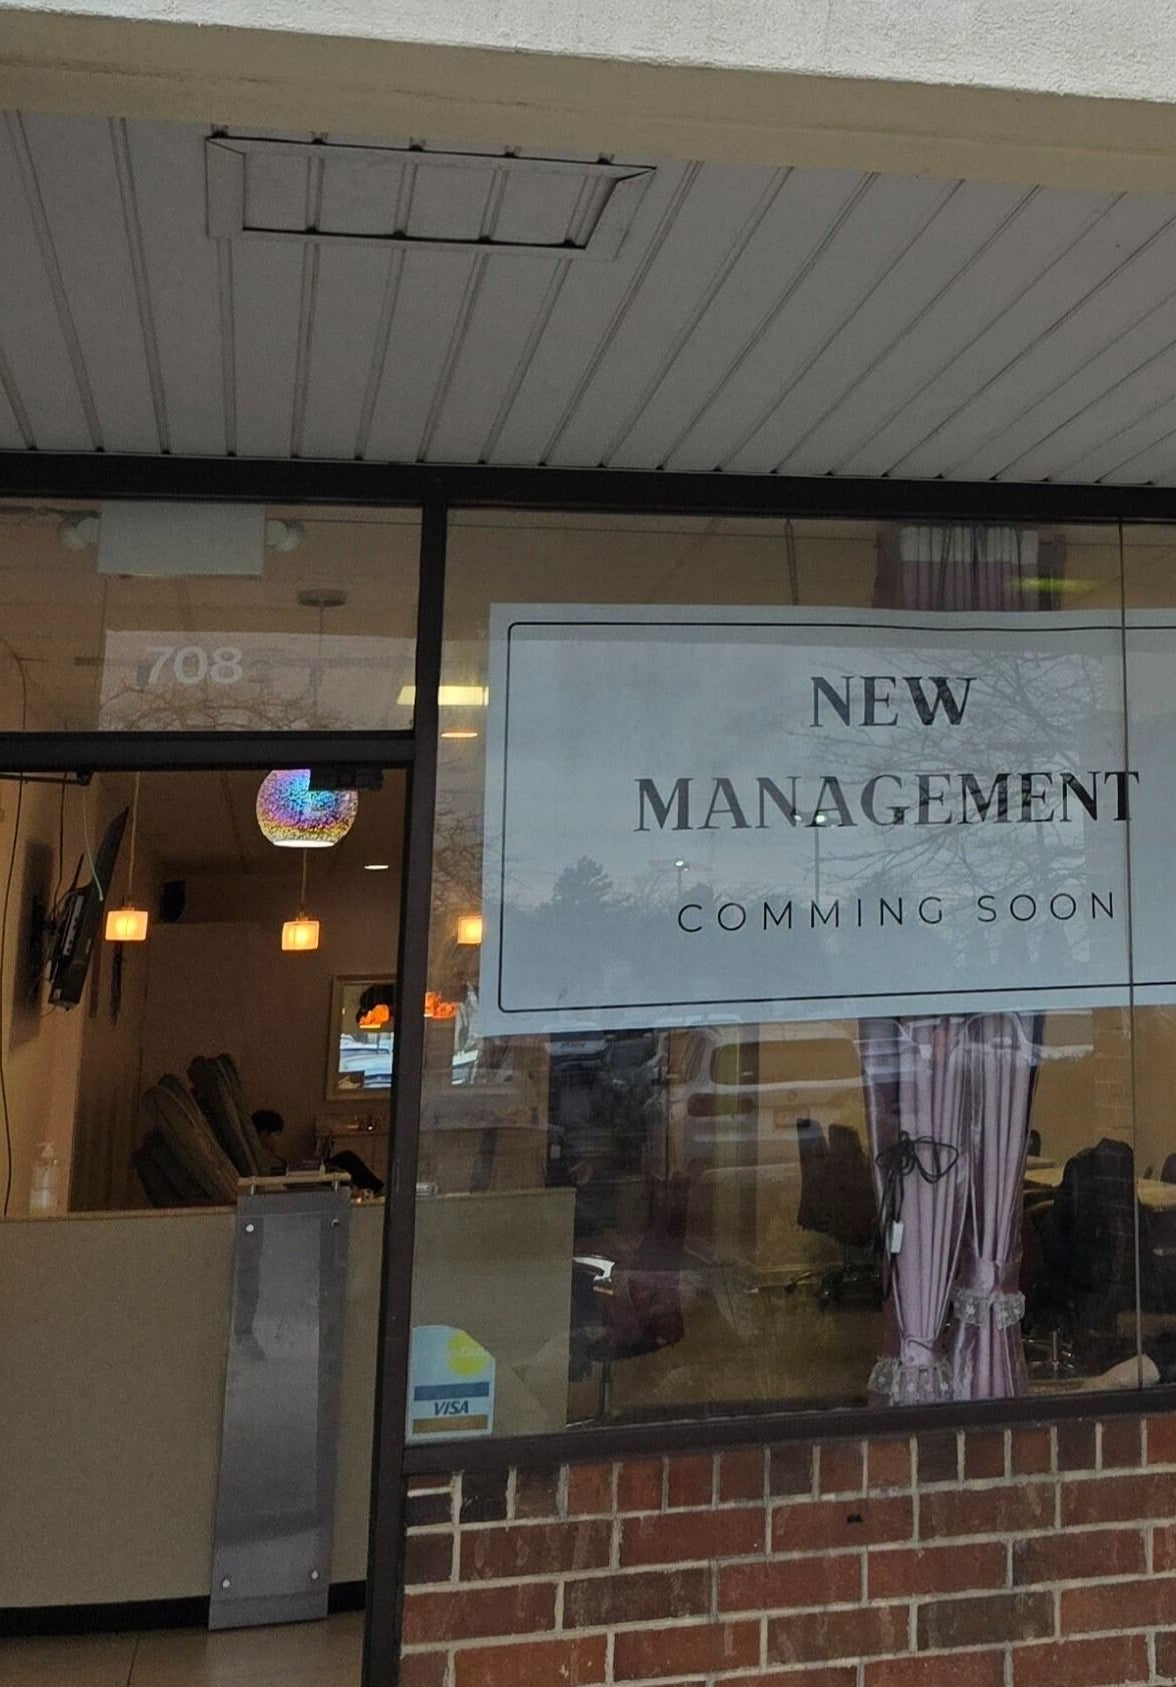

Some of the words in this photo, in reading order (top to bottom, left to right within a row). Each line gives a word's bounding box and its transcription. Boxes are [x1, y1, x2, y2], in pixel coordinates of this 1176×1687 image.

[148, 645, 243, 685] 708
[809, 675, 977, 728] NEW
[633, 770, 1140, 832] MANAGEMENT
[677, 896, 944, 933] COMMING
[977, 891, 1115, 923] SOON
[434, 1400, 470, 1416] VISA
